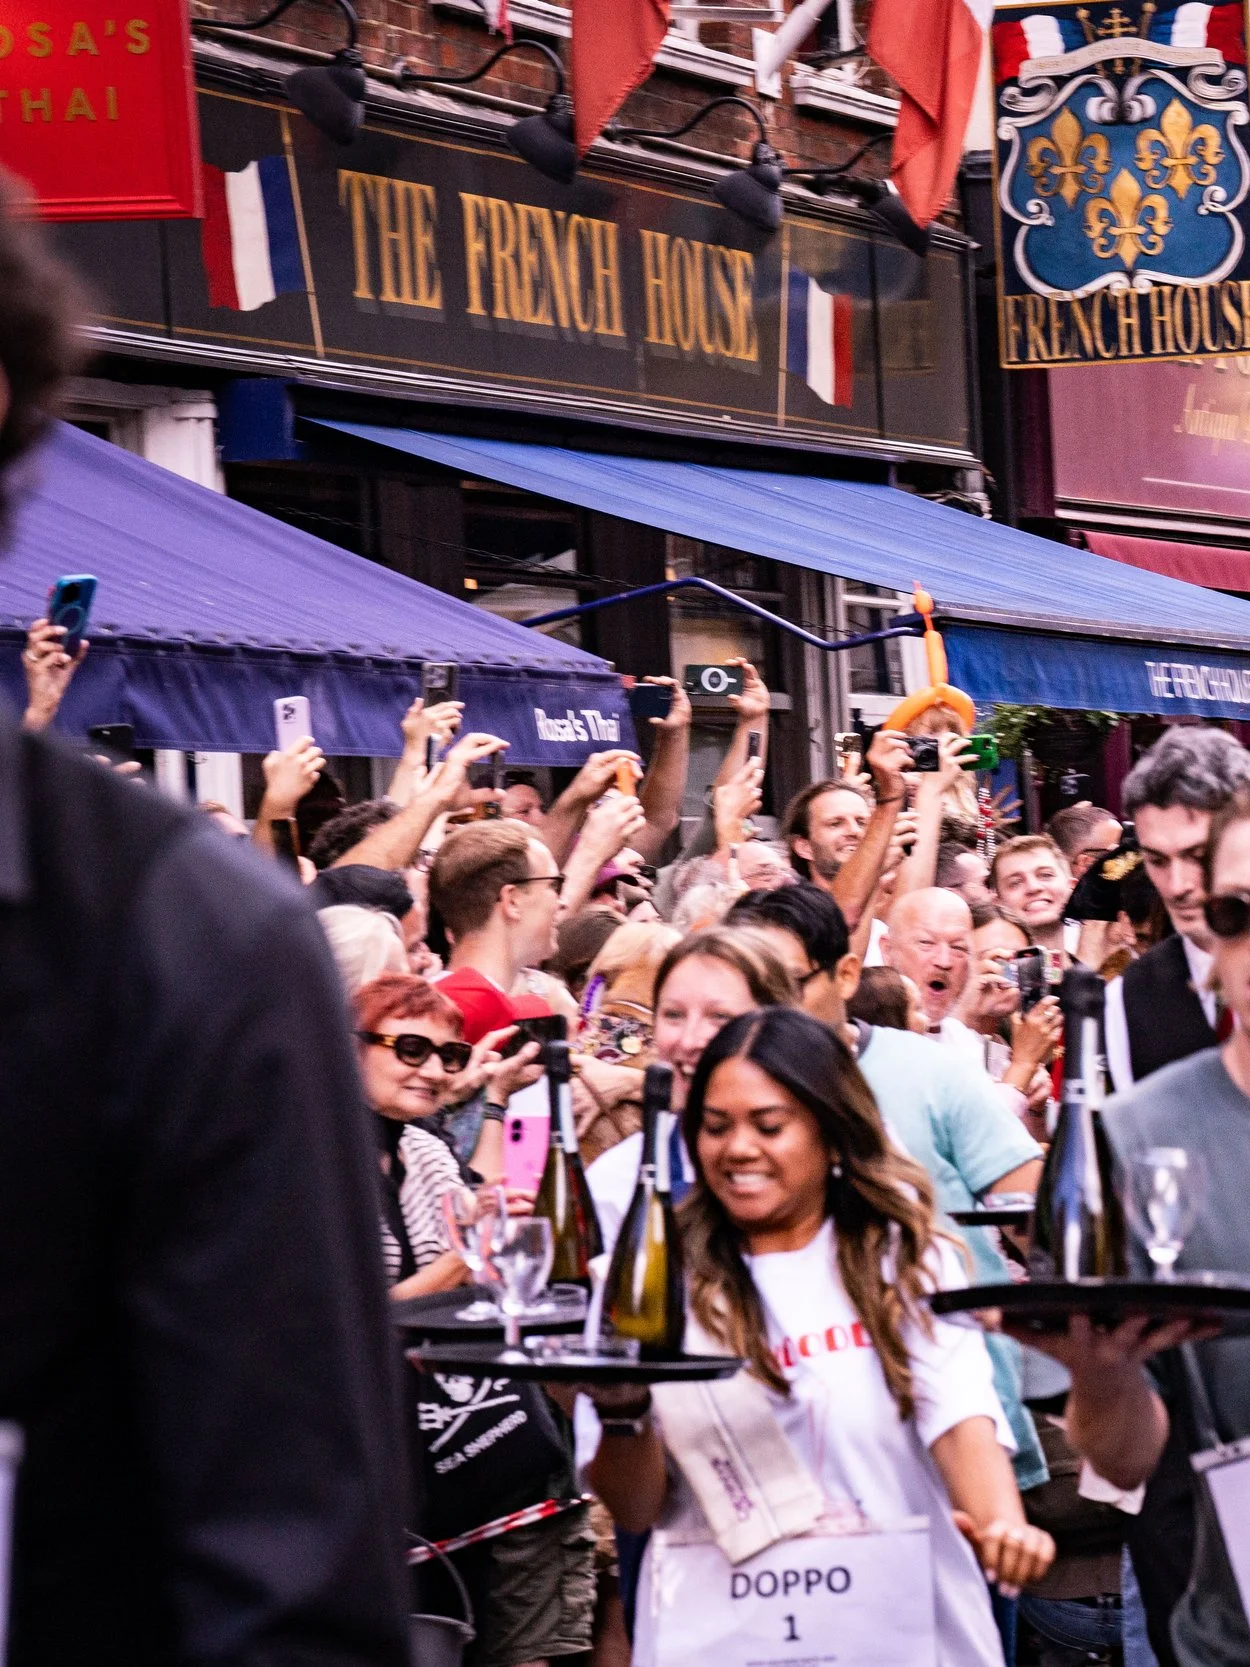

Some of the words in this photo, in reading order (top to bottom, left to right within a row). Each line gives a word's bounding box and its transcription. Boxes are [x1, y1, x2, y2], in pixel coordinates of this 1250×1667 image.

[338, 170, 443, 309] THE
[459, 192, 627, 337] FRENCH
[640, 229, 758, 361] HOUSE
[1004, 287, 1144, 362] FRENCH
[434, 1452, 467, 1474] SEA
[731, 1566, 851, 1599] DOPPO
[784, 1614, 800, 1642] 1
